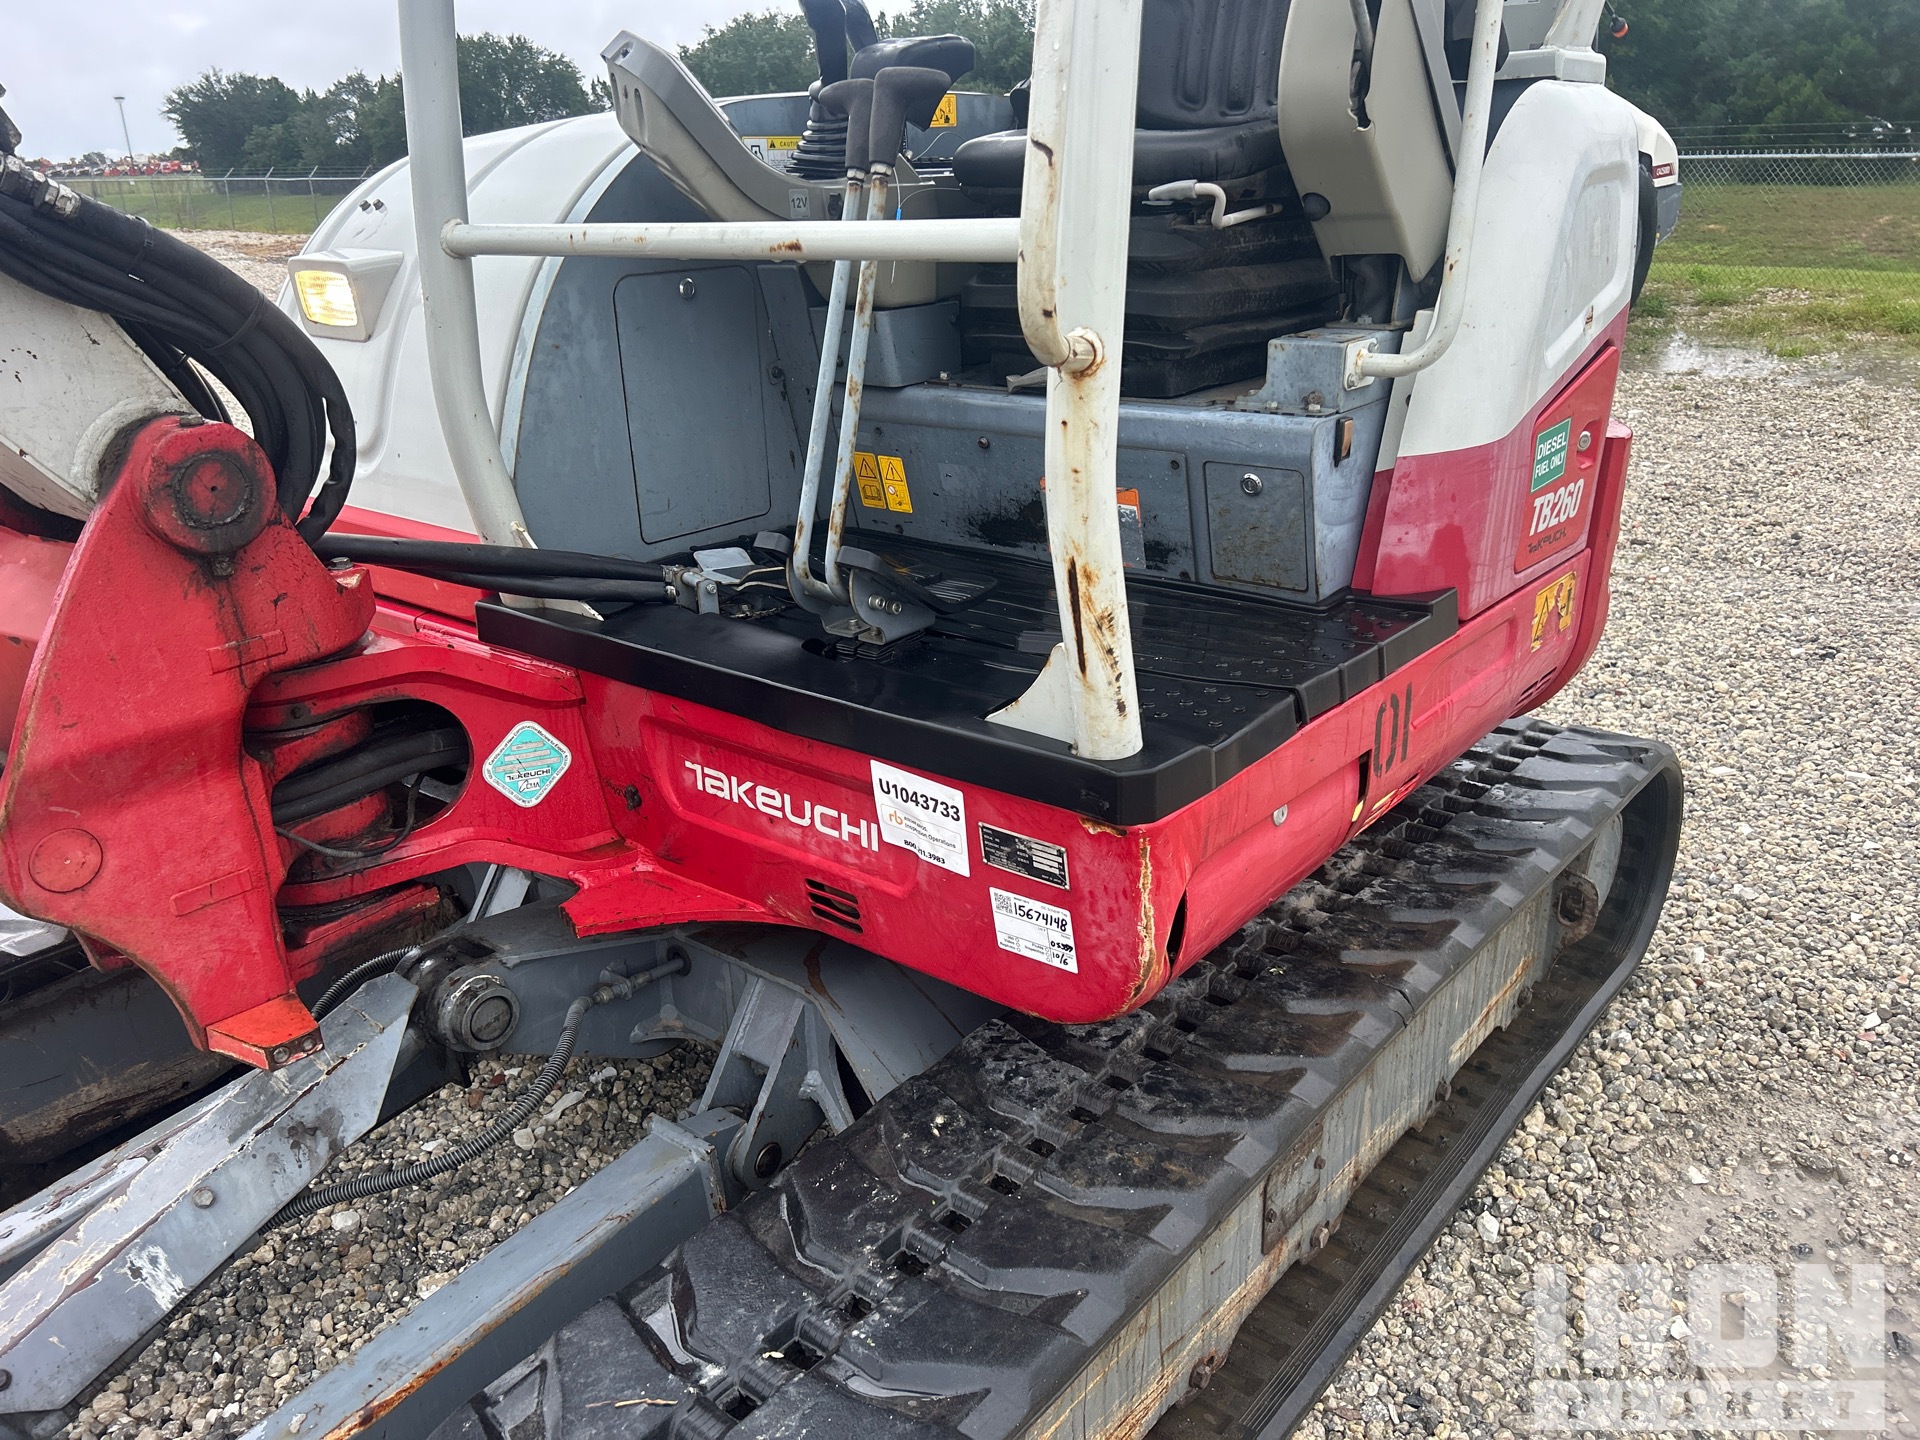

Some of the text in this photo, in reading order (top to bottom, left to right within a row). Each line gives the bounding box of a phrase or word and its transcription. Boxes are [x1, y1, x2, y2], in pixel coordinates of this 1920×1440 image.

[790, 197, 808, 209] 12V
[1537, 432, 1567, 460] DIESEL
[1535, 451, 1565, 479] FUEL ONLY
[1529, 478, 1584, 536] TB260
[879, 777, 960, 822] U1043733
[888, 810, 904, 825] rb
[928, 835, 956, 848] Operations
[1014, 902, 1068, 932] 15674148
[1052, 952, 1068, 966] 10/6
